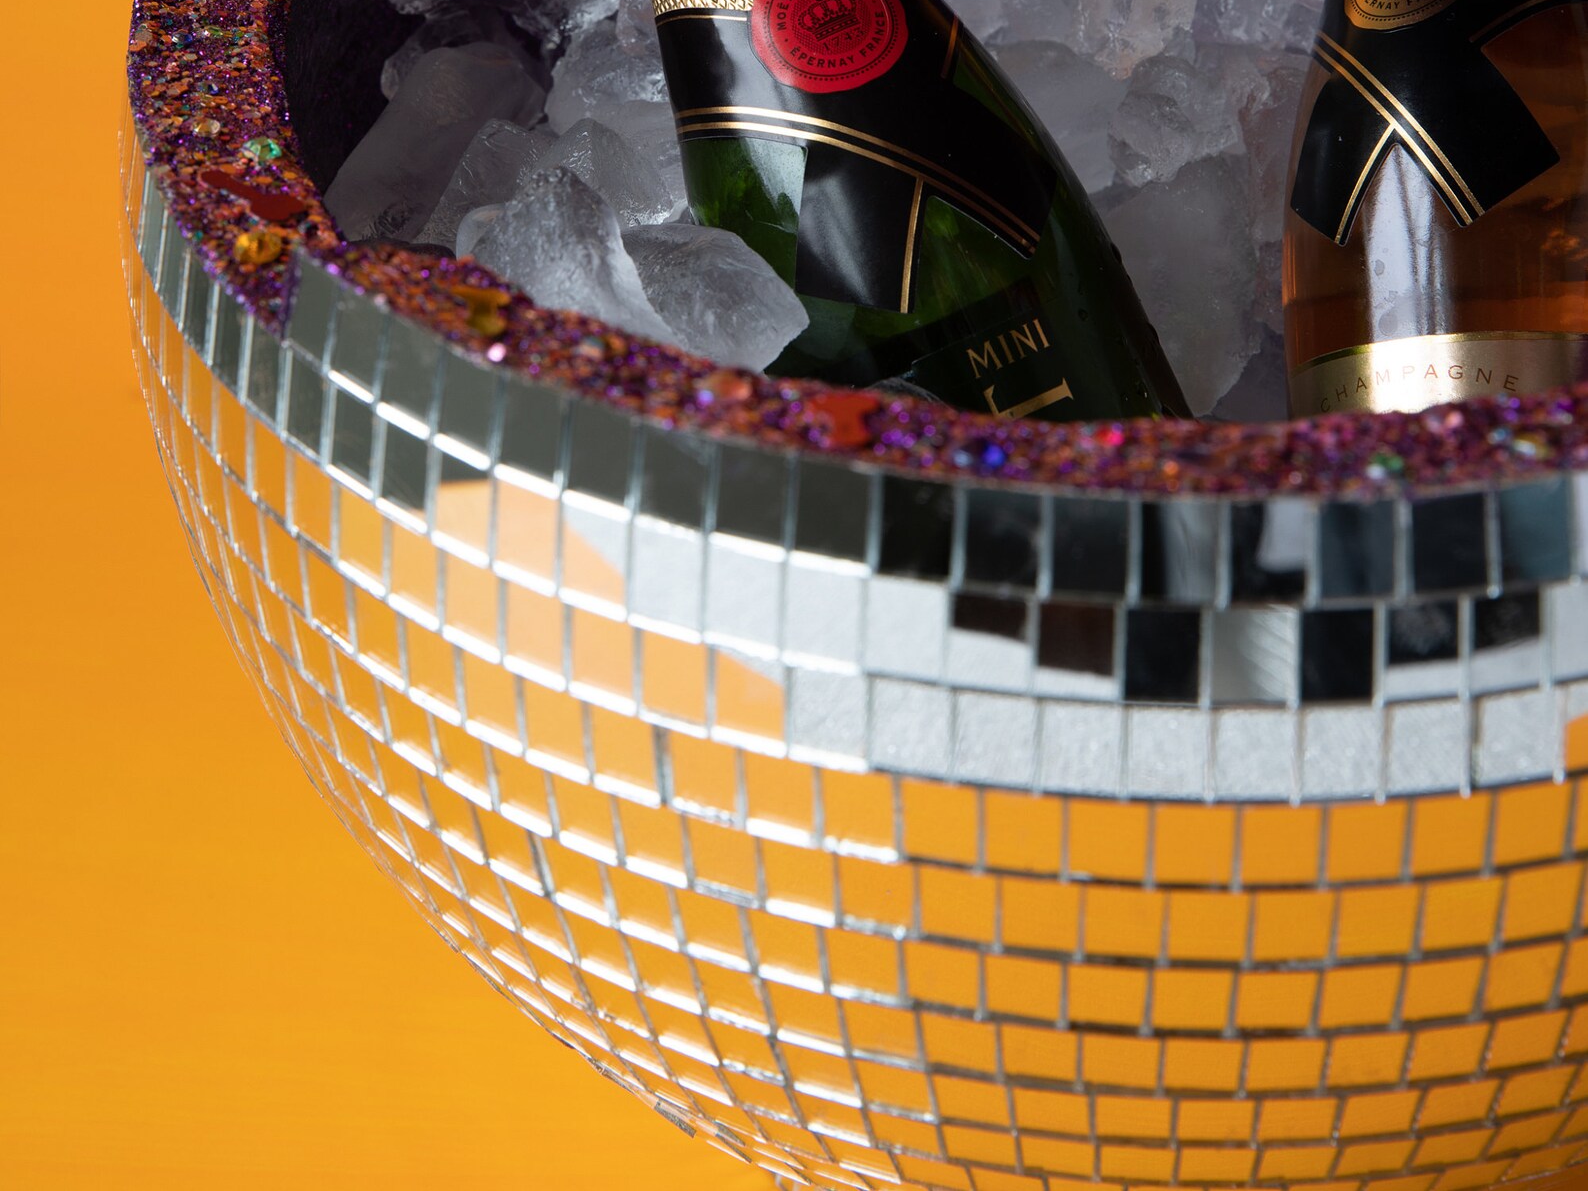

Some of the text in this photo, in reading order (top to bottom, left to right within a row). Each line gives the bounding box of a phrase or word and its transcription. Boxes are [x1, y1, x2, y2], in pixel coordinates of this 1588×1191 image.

[790, 11, 886, 69] ÉPERNAY FRANCE
[966, 318, 1050, 379] MINI
[1320, 364, 1520, 413] CHAMPAGNE
